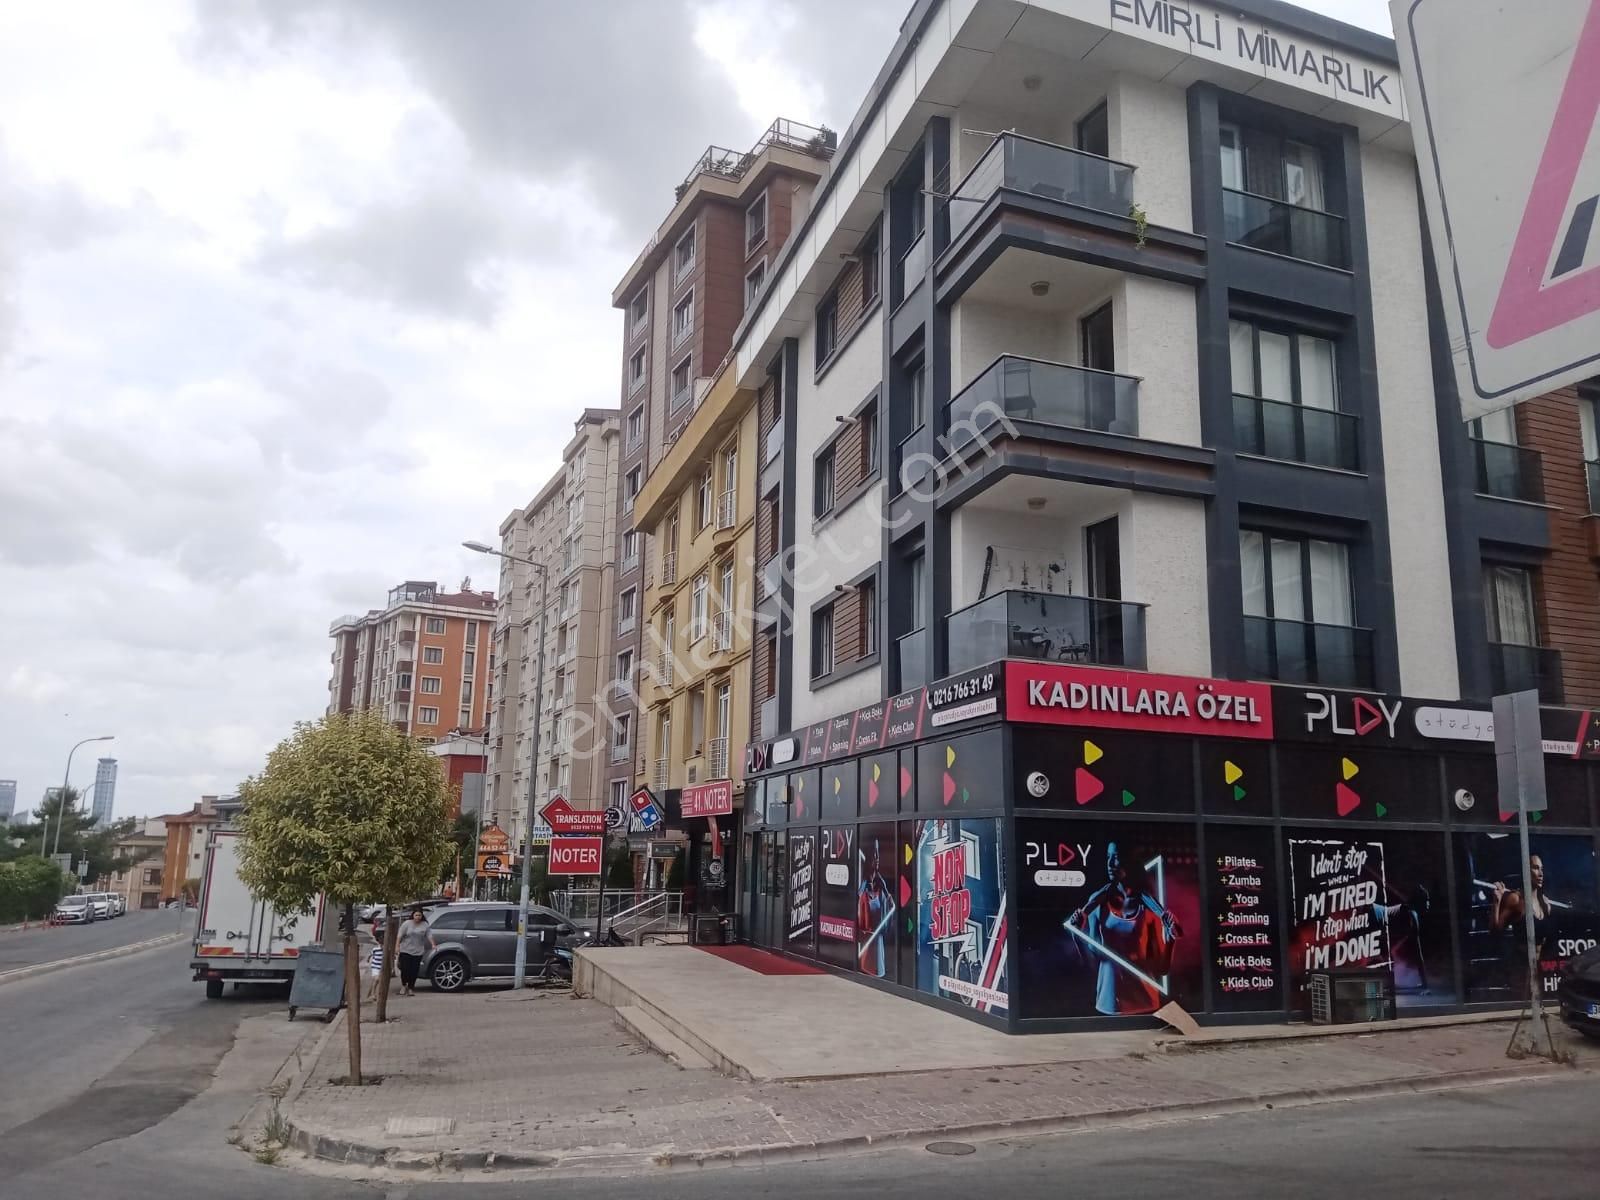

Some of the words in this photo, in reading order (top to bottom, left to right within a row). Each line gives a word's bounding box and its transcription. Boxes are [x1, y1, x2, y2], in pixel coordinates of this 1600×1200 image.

[1237, 27, 1392, 104] MİMARLIK
[933, 688, 953, 706] 0216
[953, 681, 969, 701] 766
[969, 678, 980, 696] 31
[982, 673, 994, 692] 49
[1028, 679, 1190, 717] KADINLARA
[1197, 683, 1262, 723] ÖZEL
[704, 787, 728, 811] NOTER
[555, 814, 602, 824] TRANSLATION
[552, 848, 597, 863] NOTER
[1026, 842, 1092, 867] PLAY
[1225, 855, 1257, 868] Pilates
[1316, 849, 1342, 876] don't
[1344, 845, 1368, 876] stop
[933, 844, 967, 893] NON
[1228, 874, 1261, 886] Zumba
[1328, 874, 1349, 886] WHEN
[1235, 893, 1259, 906] Yoga
[1303, 892, 1326, 920] I'M
[1328, 881, 1378, 913] TIRED
[931, 888, 971, 941] STOP
[1227, 912, 1270, 926] Spinning
[1322, 916, 1343, 939] stop
[1344, 908, 1370, 933] when
[1225, 933, 1254, 944] Cross
[1256, 933, 1269, 944] Fit
[1335, 930, 1382, 967] DONE
[1224, 956, 1245, 967] Kick
[1247, 956, 1272, 967] Boks
[1228, 977, 1250, 988] Kids
[1251, 976, 1274, 988] Club
